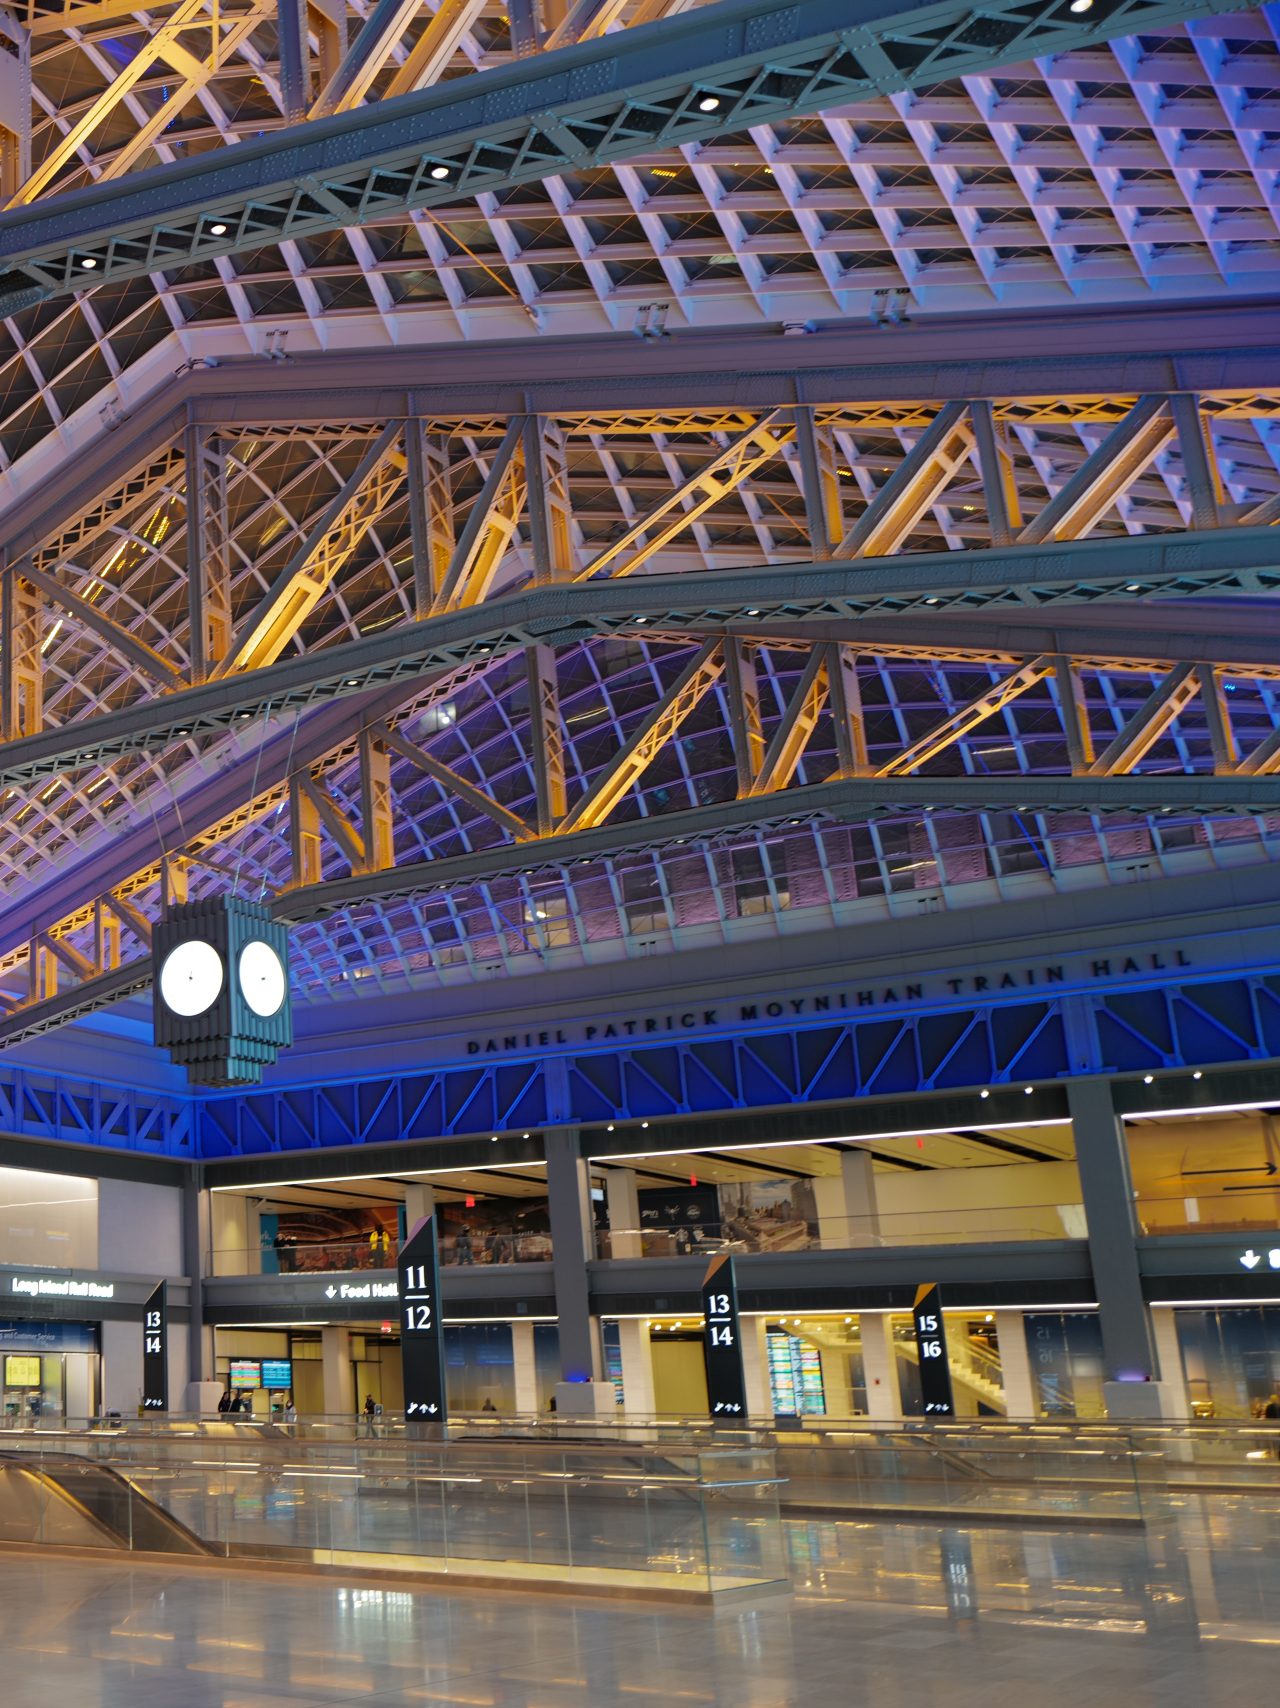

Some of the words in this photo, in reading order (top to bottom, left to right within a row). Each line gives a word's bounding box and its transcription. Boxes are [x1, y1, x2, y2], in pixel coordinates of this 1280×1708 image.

[467, 1030, 567, 1055] DANIEL
[586, 1010, 718, 1040] PATRICK
[740, 984, 923, 1021] MOYNIHAN
[947, 966, 1064, 995] TRAIN
[1092, 950, 1192, 977] HALL
[12, 1277, 38, 1297] Long
[39, 1279, 69, 1295] Island
[68, 1281, 88, 1296] Rail
[88, 1282, 114, 1298] Road
[405, 1265, 427, 1290] 11
[340, 1283, 371, 1299] Food
[372, 1282, 399, 1297] Hall
[708, 1294, 730, 1314] 13
[147, 1311, 160, 1327] 13
[405, 1305, 431, 1330] 12
[919, 1315, 938, 1332] 15
[146, 1337, 161, 1354] 14
[710, 1326, 734, 1346] 14
[923, 1341, 942, 1358] 16
